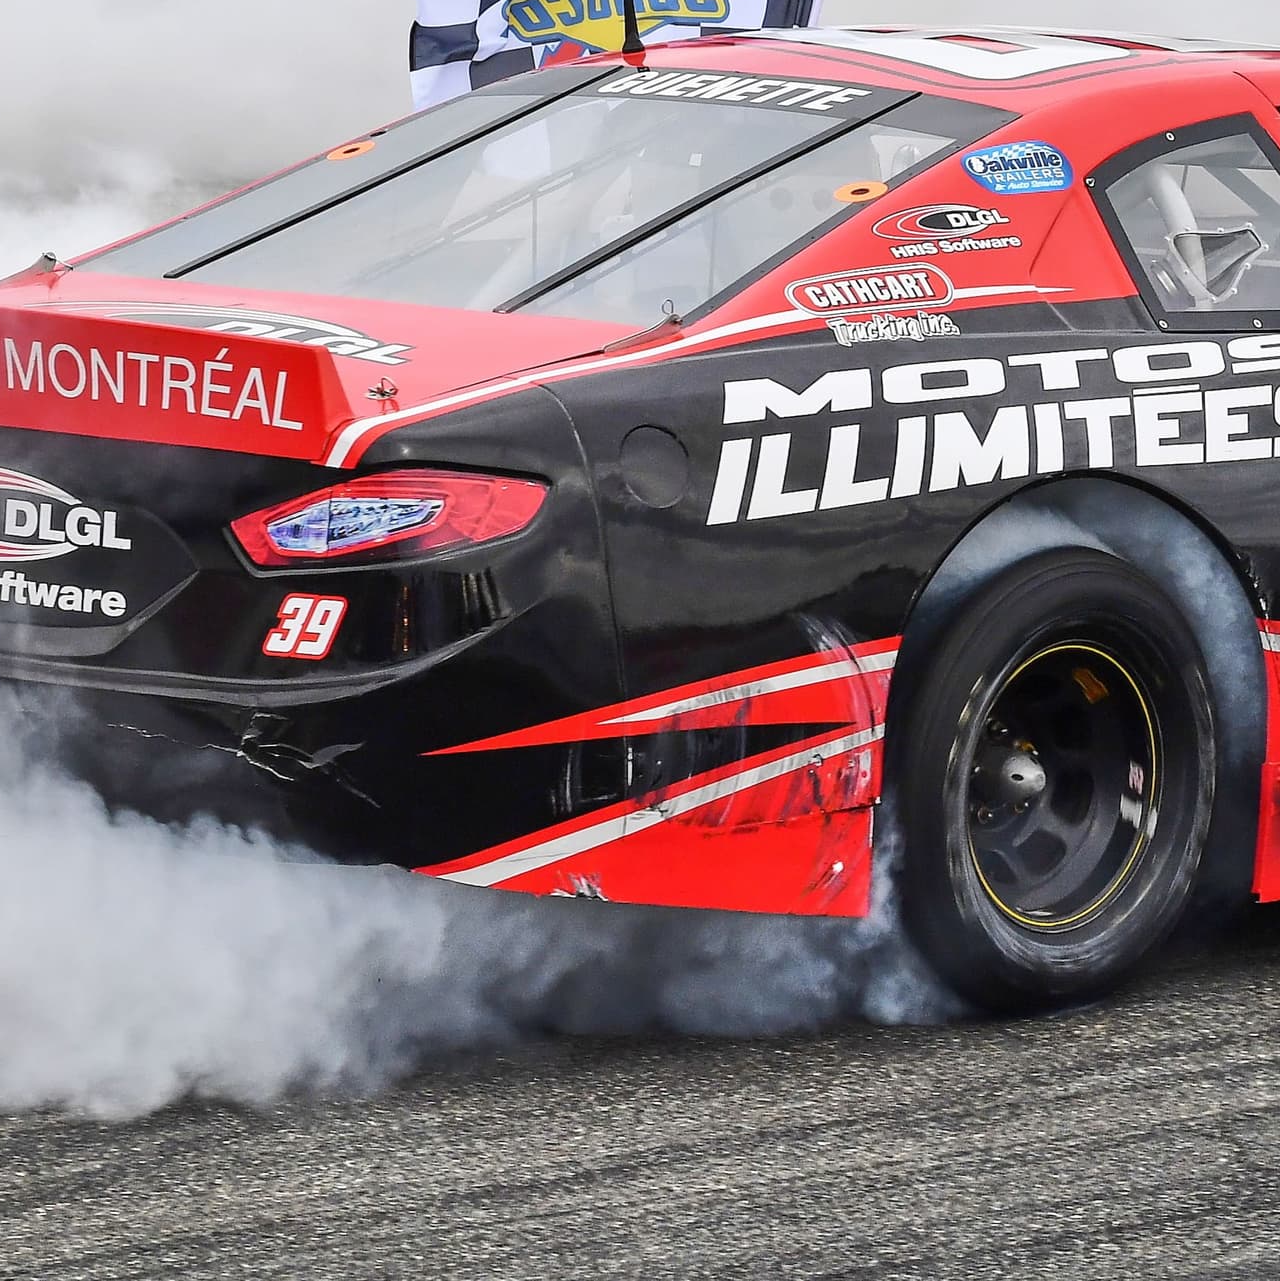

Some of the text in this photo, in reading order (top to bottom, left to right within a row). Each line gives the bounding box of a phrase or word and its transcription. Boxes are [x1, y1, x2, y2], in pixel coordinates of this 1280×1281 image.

[597, 71, 872, 111] GUENETTE
[967, 151, 1062, 174] Oakville
[982, 168, 1065, 184] TRAILERS
[945, 209, 1011, 228] DLGL
[890, 236, 1023, 259] HRIS Software
[805, 272, 935, 308] CATHCART
[826, 311, 922, 347] Trucking
[4, 347, 304, 431] MONTRÉAL
[6, 498, 131, 550] DLGL
[264, 594, 343, 658] 39
